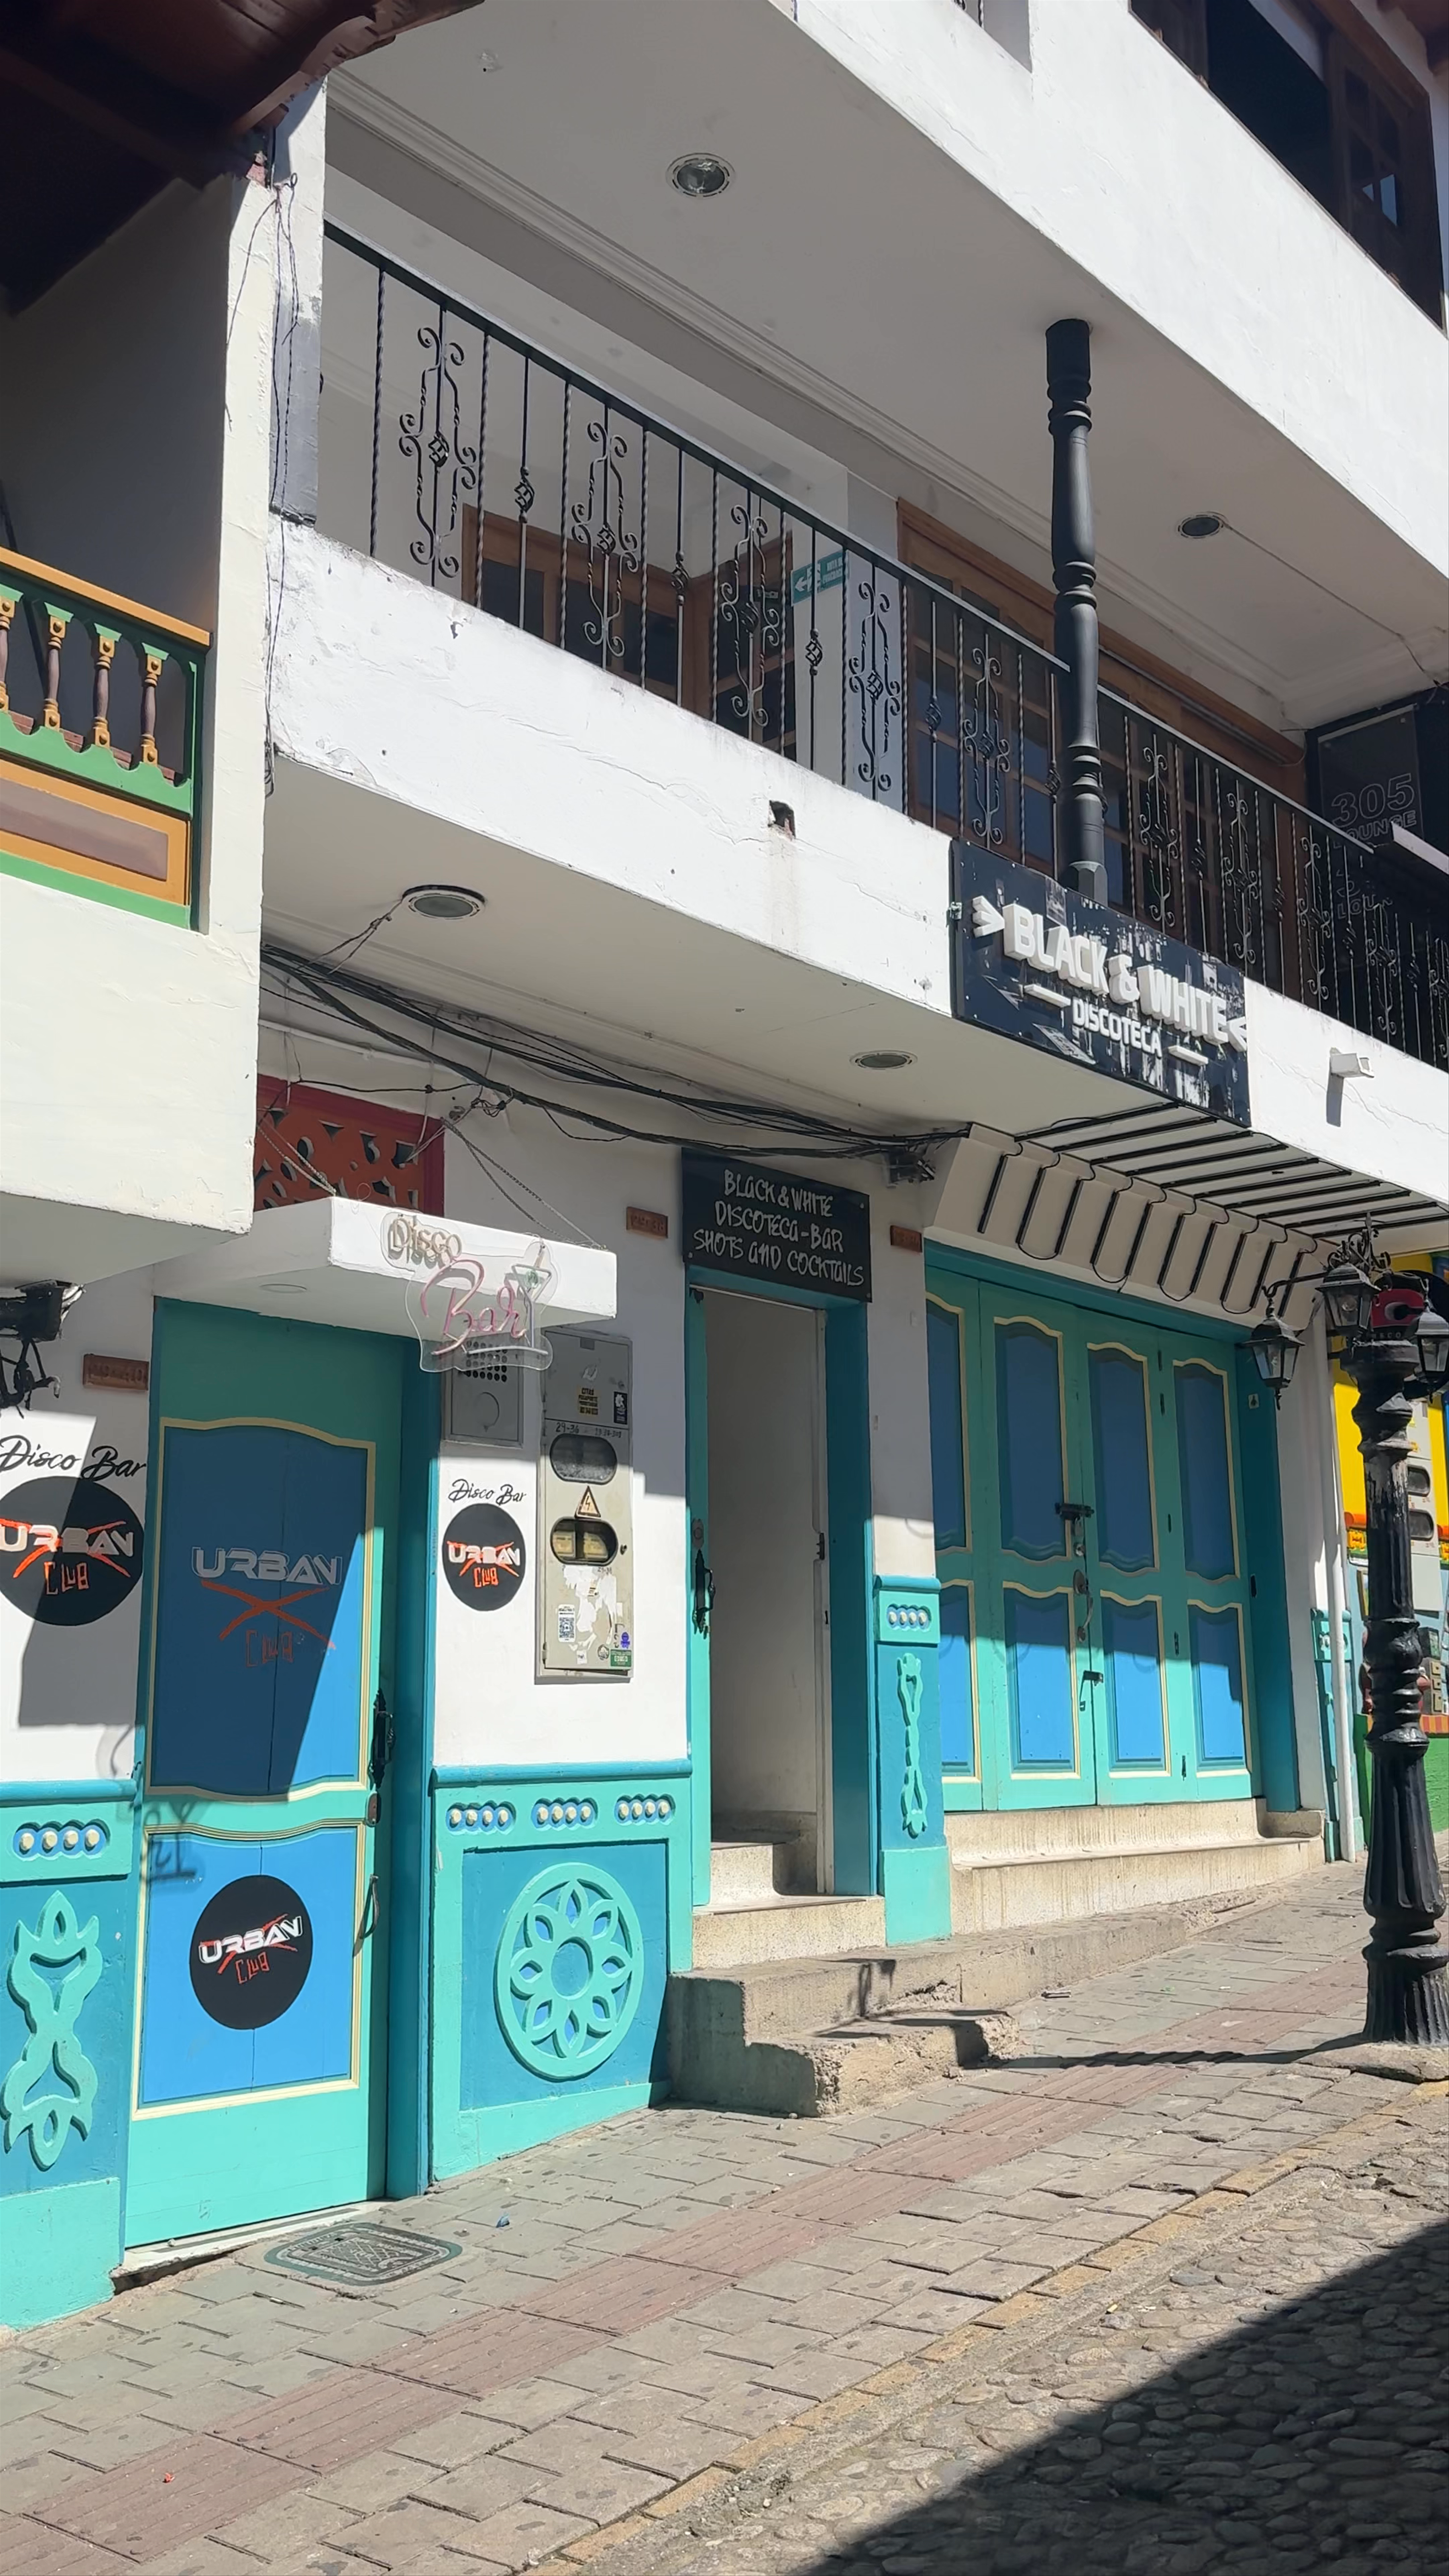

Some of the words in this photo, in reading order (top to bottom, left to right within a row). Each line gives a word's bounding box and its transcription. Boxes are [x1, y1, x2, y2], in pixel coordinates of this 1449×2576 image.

[1331, 773, 1415, 828] 305
[1003, 901, 1109, 996] BLACK
[1108, 954, 1140, 1004] &
[1137, 964, 1229, 1046] WHITE
[1072, 997, 1162, 1058] DISCOTECA
[778, 1186, 789, 1208] &
[791, 1188, 833, 1217] WHITE
[693, 1229, 744, 1259] SHOTS
[0, 1435, 82, 1472] Disco
[80, 1446, 146, 1481] Bar
[448, 1478, 495, 1503] Disco
[495, 1484, 527, 1506] Bar
[0, 1524, 134, 1557] URBAN
[448, 1544, 520, 1566] URBAN
[192, 1547, 343, 1585] URBAN
[198, 1915, 303, 1964] URBAN
